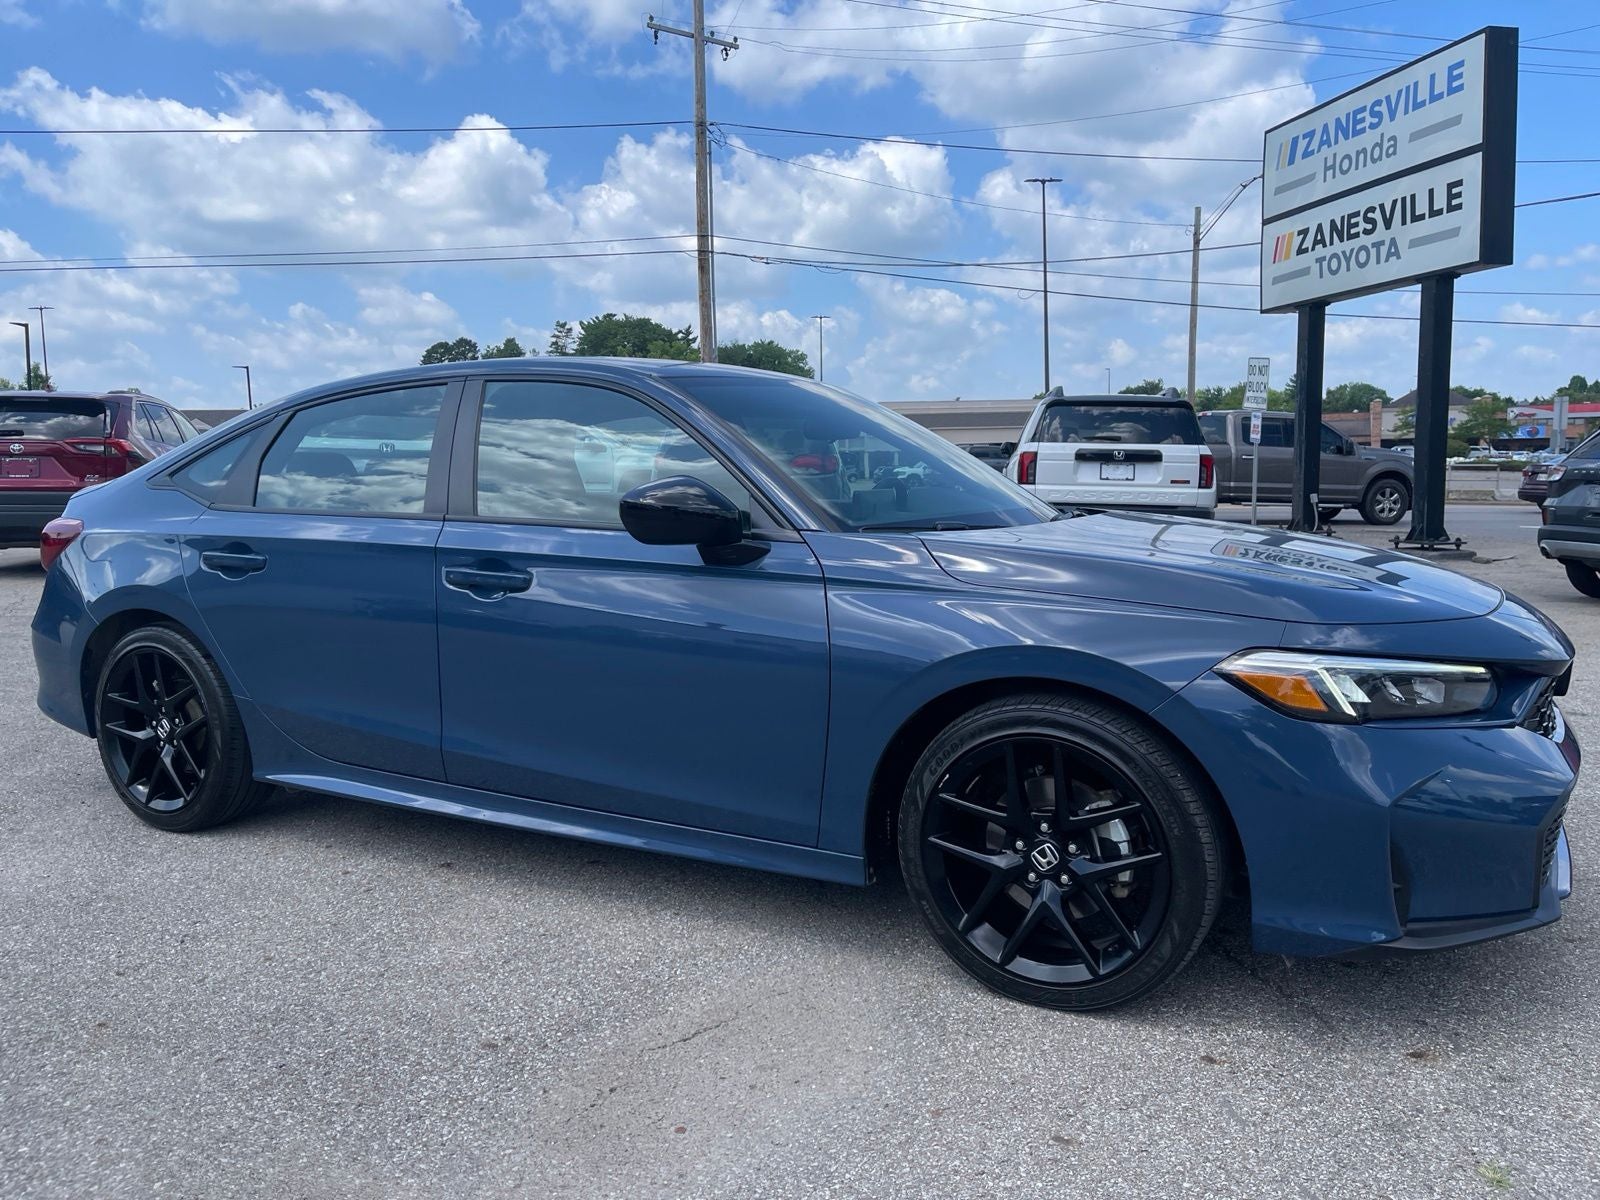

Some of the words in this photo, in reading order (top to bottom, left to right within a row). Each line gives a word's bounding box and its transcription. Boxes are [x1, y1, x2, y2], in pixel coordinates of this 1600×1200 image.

[1301, 59, 1466, 160] ZANESVILLE
[1322, 132, 1398, 183] Honda
[1295, 178, 1464, 257] ZANESVILLE
[1314, 236, 1402, 280] TOYOTA
[1248, 364, 1257, 376] DO
[1258, 365, 1269, 377] NOT
[1248, 381, 1267, 393] BLOCK
[1049, 489, 1187, 503] PASSPORT
